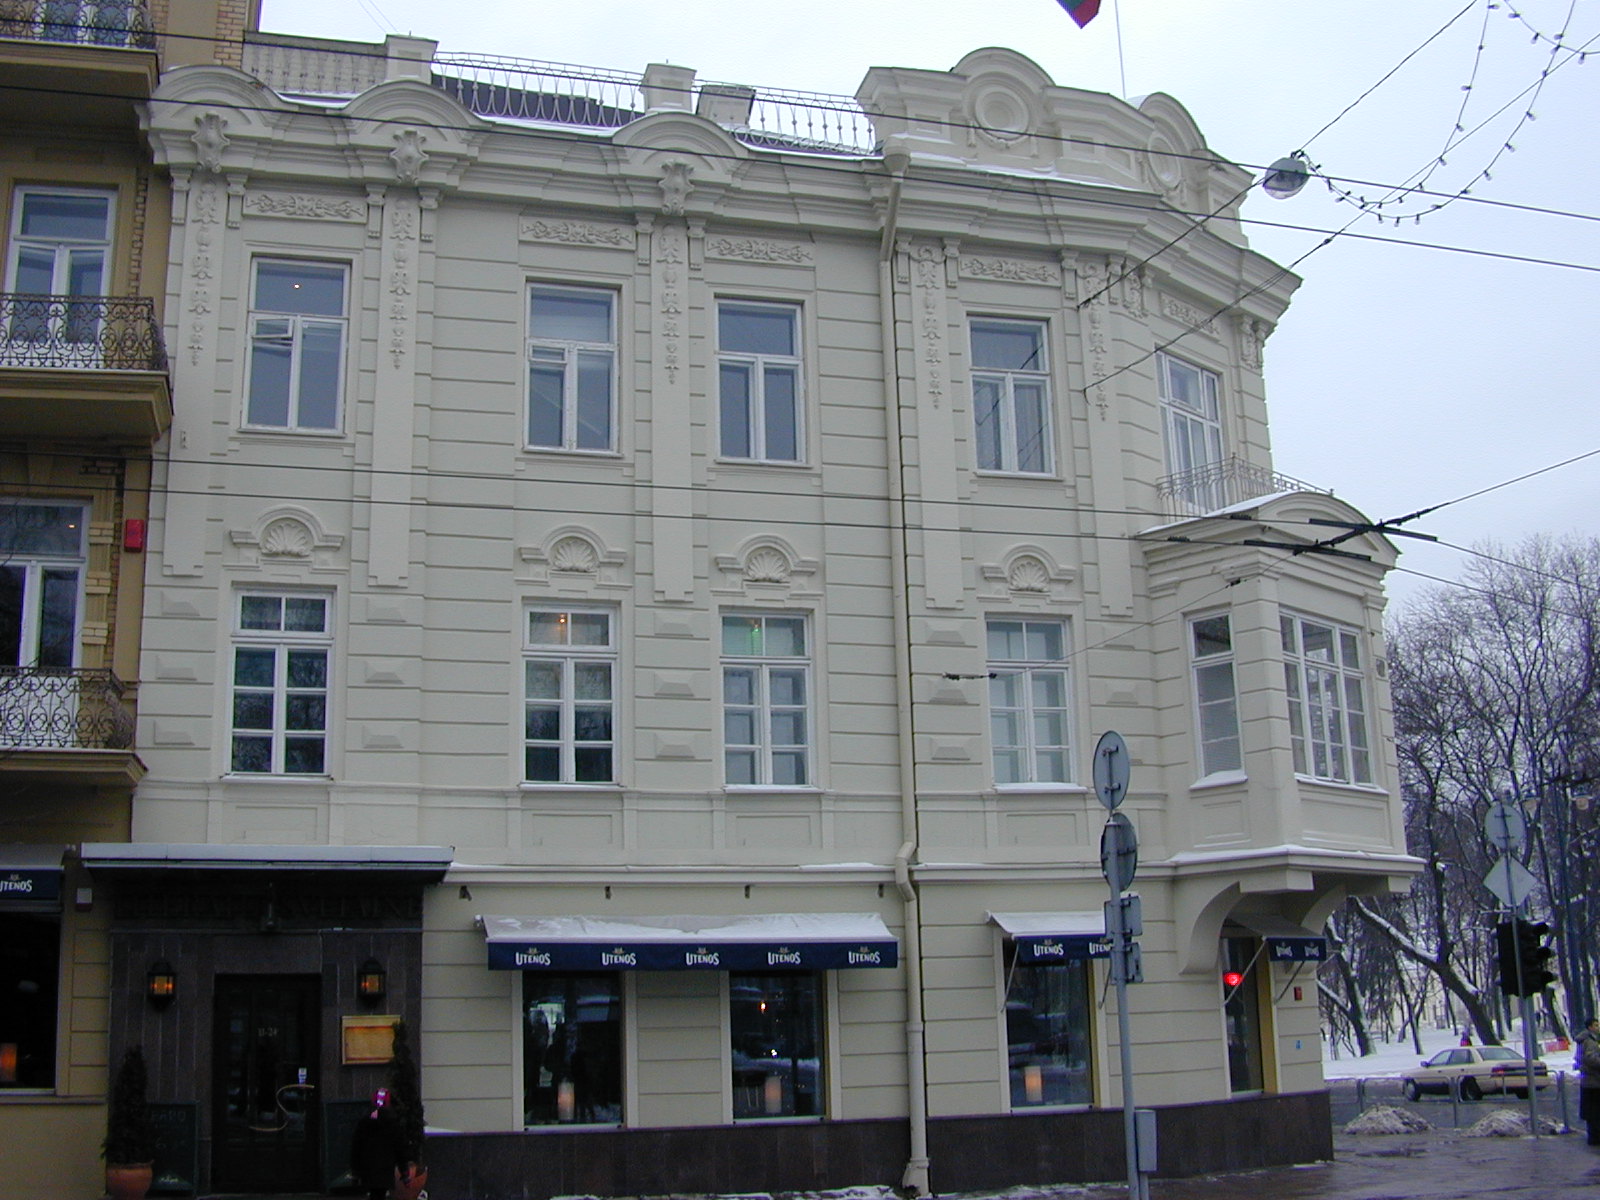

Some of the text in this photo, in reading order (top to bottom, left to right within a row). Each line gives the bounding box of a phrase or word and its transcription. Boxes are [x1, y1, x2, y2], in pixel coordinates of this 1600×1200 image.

[1033, 943, 1064, 957] UTENOS
[515, 951, 881, 966] UTENOS UTENOS UTENOS UTENOS UTENOS
